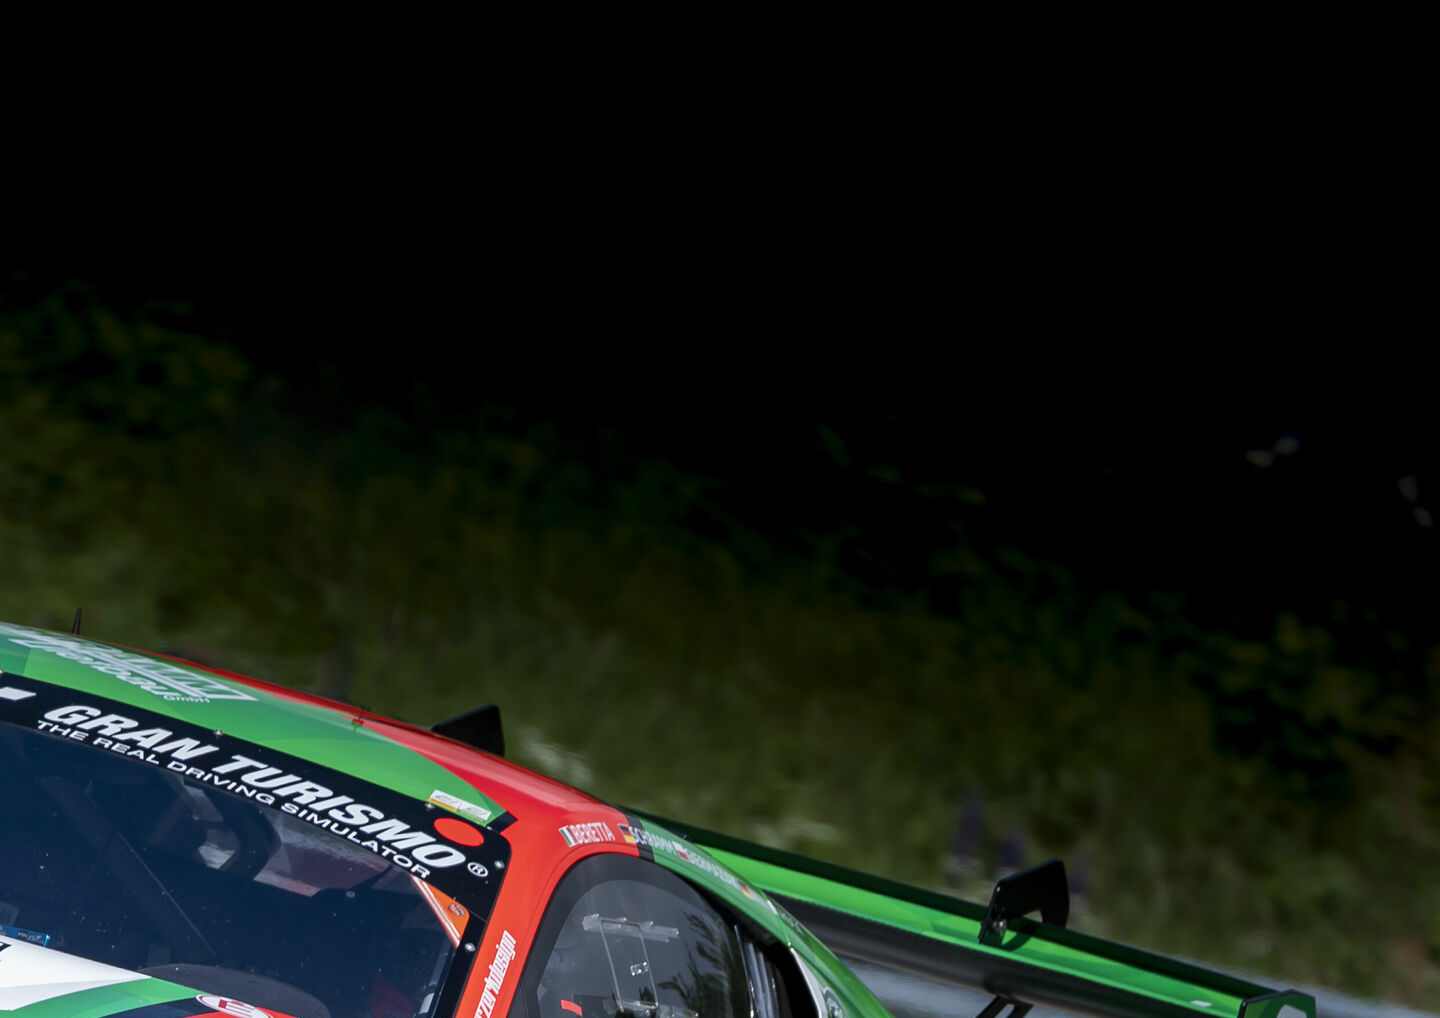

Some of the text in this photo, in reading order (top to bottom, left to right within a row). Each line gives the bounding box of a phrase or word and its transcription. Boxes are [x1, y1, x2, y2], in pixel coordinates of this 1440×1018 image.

[37, 720, 89, 742] THE
[92, 737, 160, 766] REAL
[167, 760, 276, 807] DRIVING
[280, 802, 431, 879] SIMULATOR
[43, 705, 220, 763] GRAN
[212, 754, 466, 870] TURISMO
[570, 821, 616, 845] BERETTA
